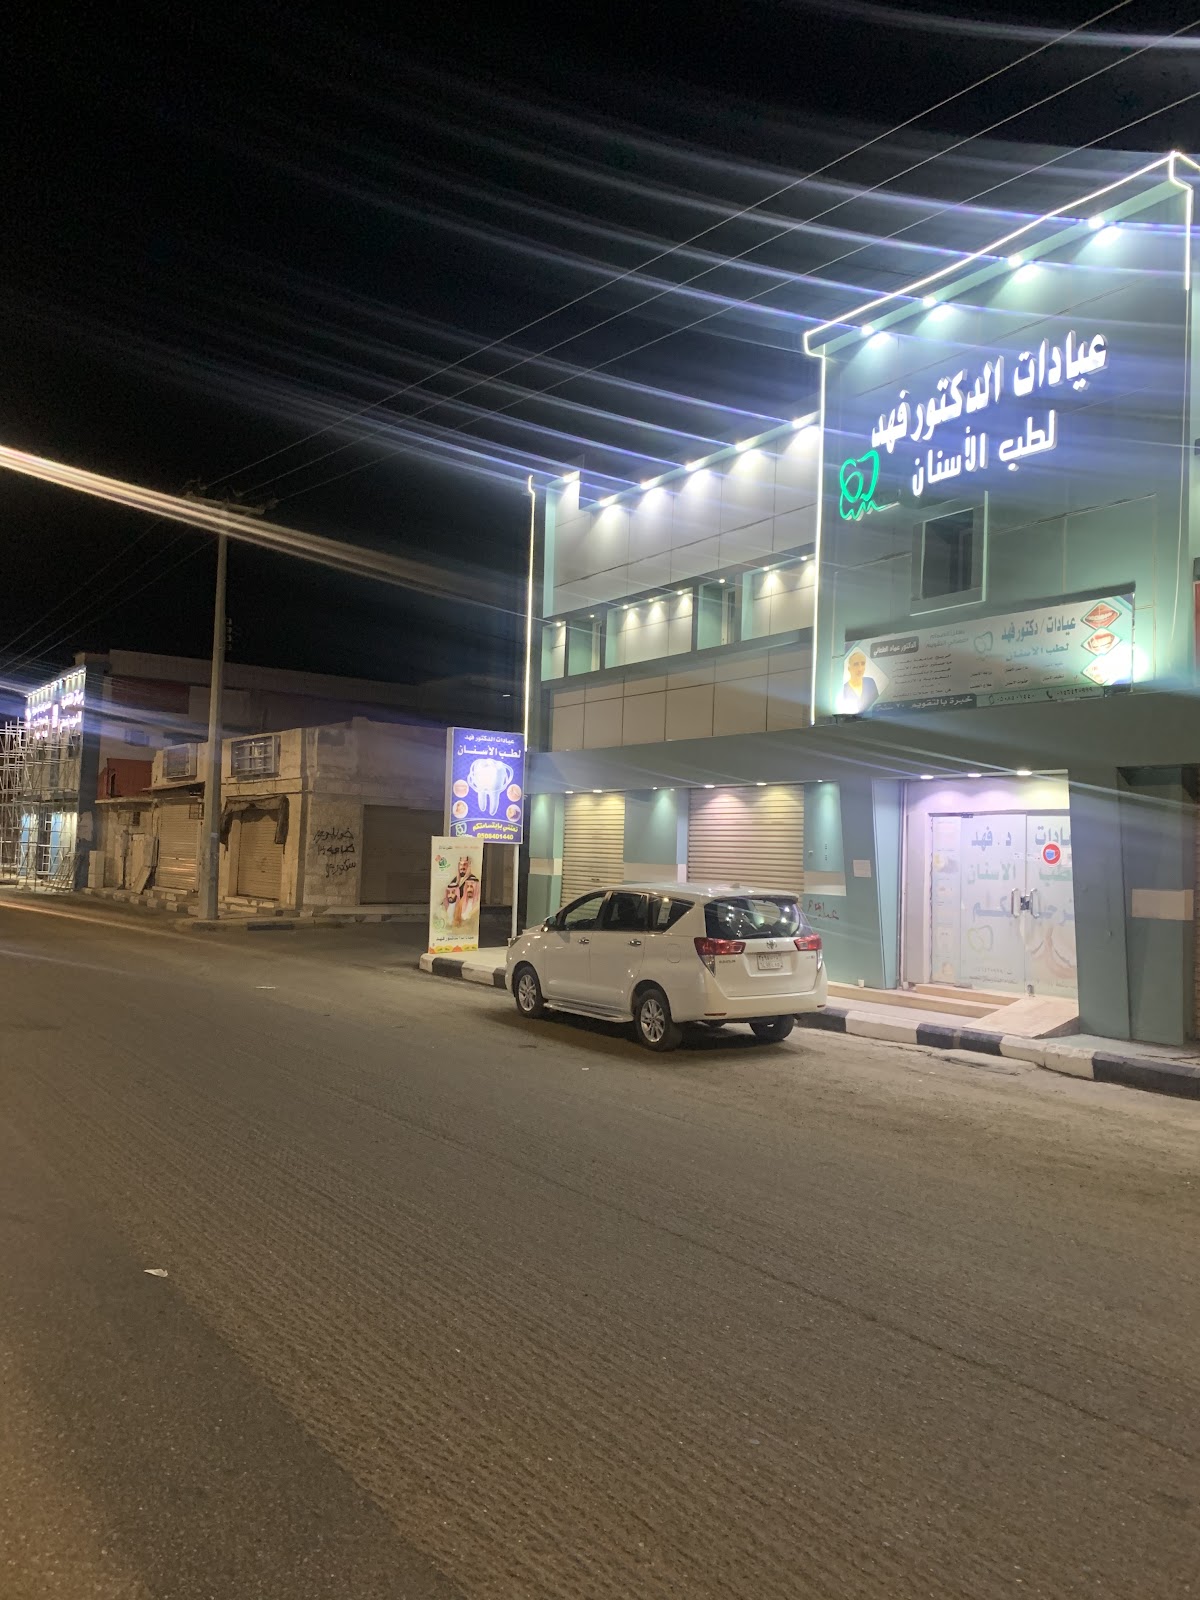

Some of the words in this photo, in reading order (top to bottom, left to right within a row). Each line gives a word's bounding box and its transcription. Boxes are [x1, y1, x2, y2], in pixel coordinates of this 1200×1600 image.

[1013, 329, 1108, 397] عيادات
[910, 355, 1004, 442] الدكتور
[871, 389, 910, 454] فهد
[998, 409, 1057, 472] لطب
[911, 425, 989, 498] الأسنان
[1001, 621, 1016, 643] فهد
[1017, 618, 1039, 642] دكتور
[1046, 616, 1077, 636] عيادات
[900, 641, 917, 653] الدكتور
[1045, 642, 1070, 656] لطب
[949, 695, 973, 705] خبرة
[475, 735, 496, 743] الدكتور
[496, 736, 515, 746] عيادات
[457, 744, 498, 756] الأسنان
[498, 749, 522, 760] لطب
[971, 825, 993, 851] فهد
